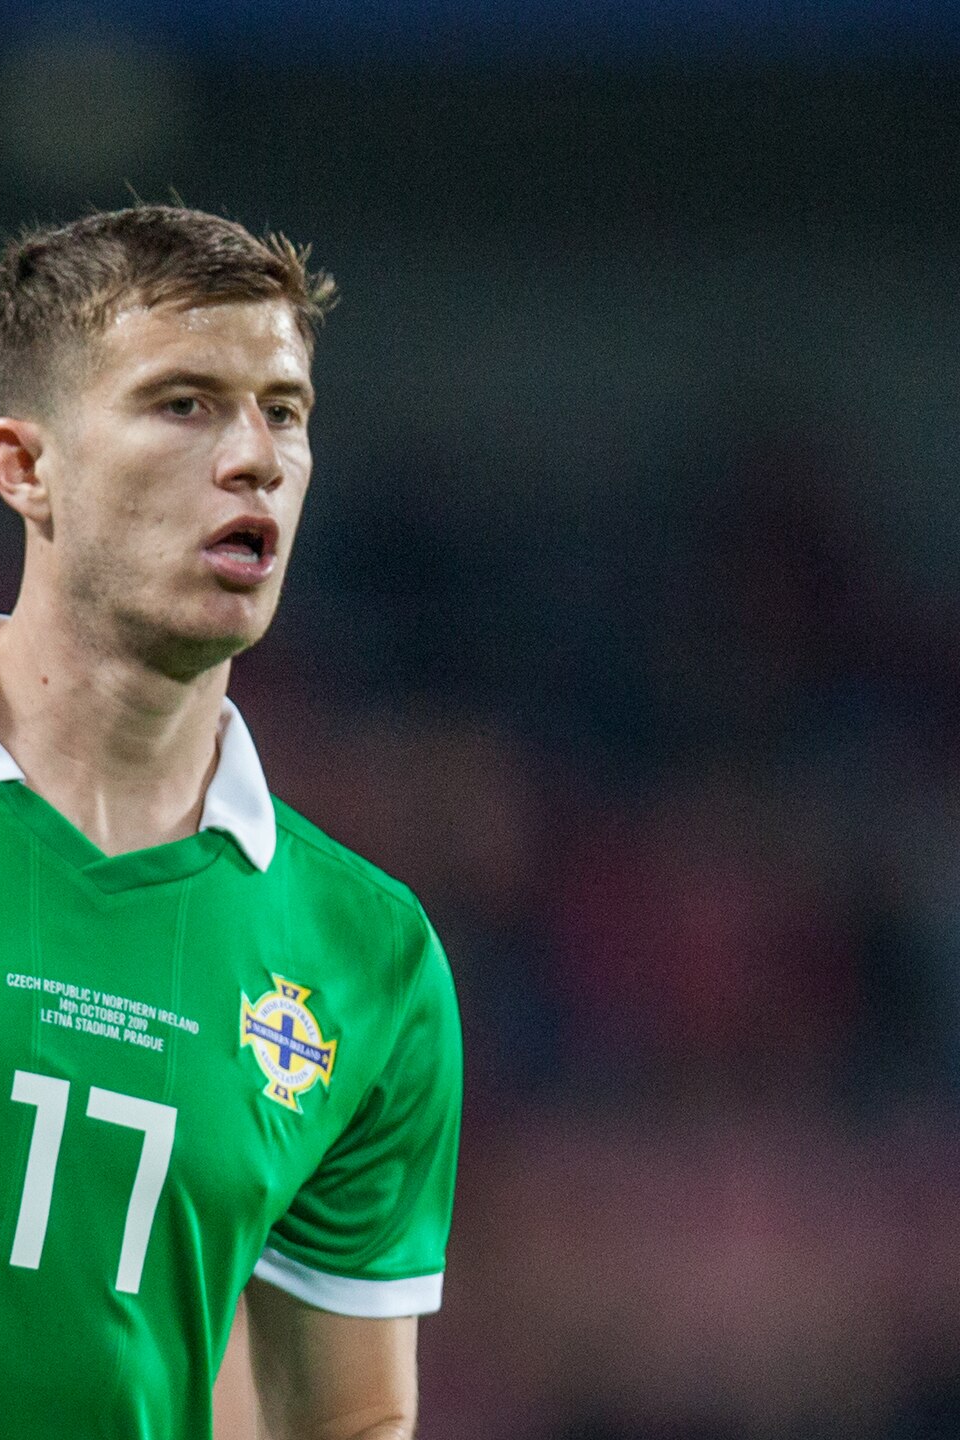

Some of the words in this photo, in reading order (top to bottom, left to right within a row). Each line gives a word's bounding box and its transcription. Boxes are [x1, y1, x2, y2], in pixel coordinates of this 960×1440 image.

[6, 972, 41, 990] CZECH
[43, 979, 91, 1002] REPUBLIC
[93, 990, 101, 1005] V
[102, 993, 156, 1019] NORTHERN
[158, 1009, 200, 1034] IRELAND
[59, 997, 79, 1014] 14th
[80, 1003, 126, 1026] OCTOBER
[128, 1015, 148, 1032] 2019
[75, 1017, 121, 1041] STADIUM,
[123, 1028, 164, 1052] PRAGUE
[289, 1038, 321, 1061] IRELAND
[10, 1070, 178, 1295] 17
